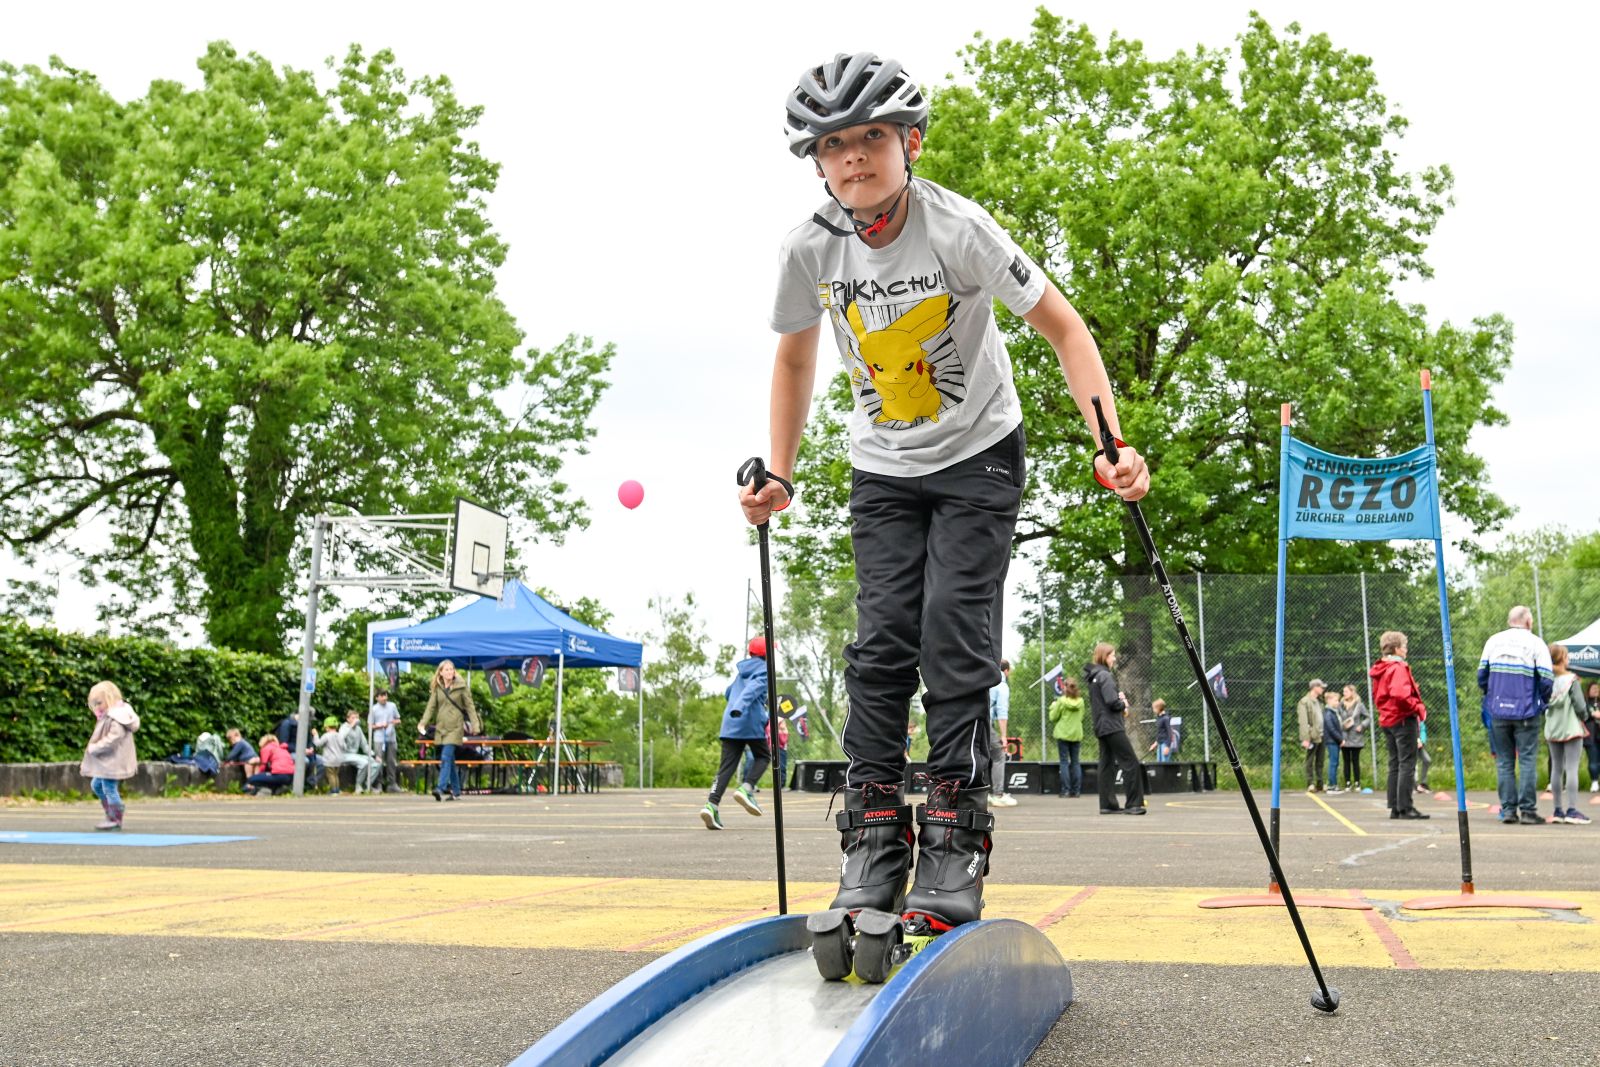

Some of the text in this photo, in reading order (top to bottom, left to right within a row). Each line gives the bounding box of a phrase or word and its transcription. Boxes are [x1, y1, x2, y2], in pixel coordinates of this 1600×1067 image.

[832, 271, 944, 301] PIKACHU!
[1304, 457, 1419, 475] RENNGRUPPE
[1298, 474, 1416, 510] RGZO
[1296, 510, 1414, 523] ZÜRCHER OBERLAND
[1161, 584, 1184, 625] ATOMIC
[864, 809, 897, 819] ATOMIC
